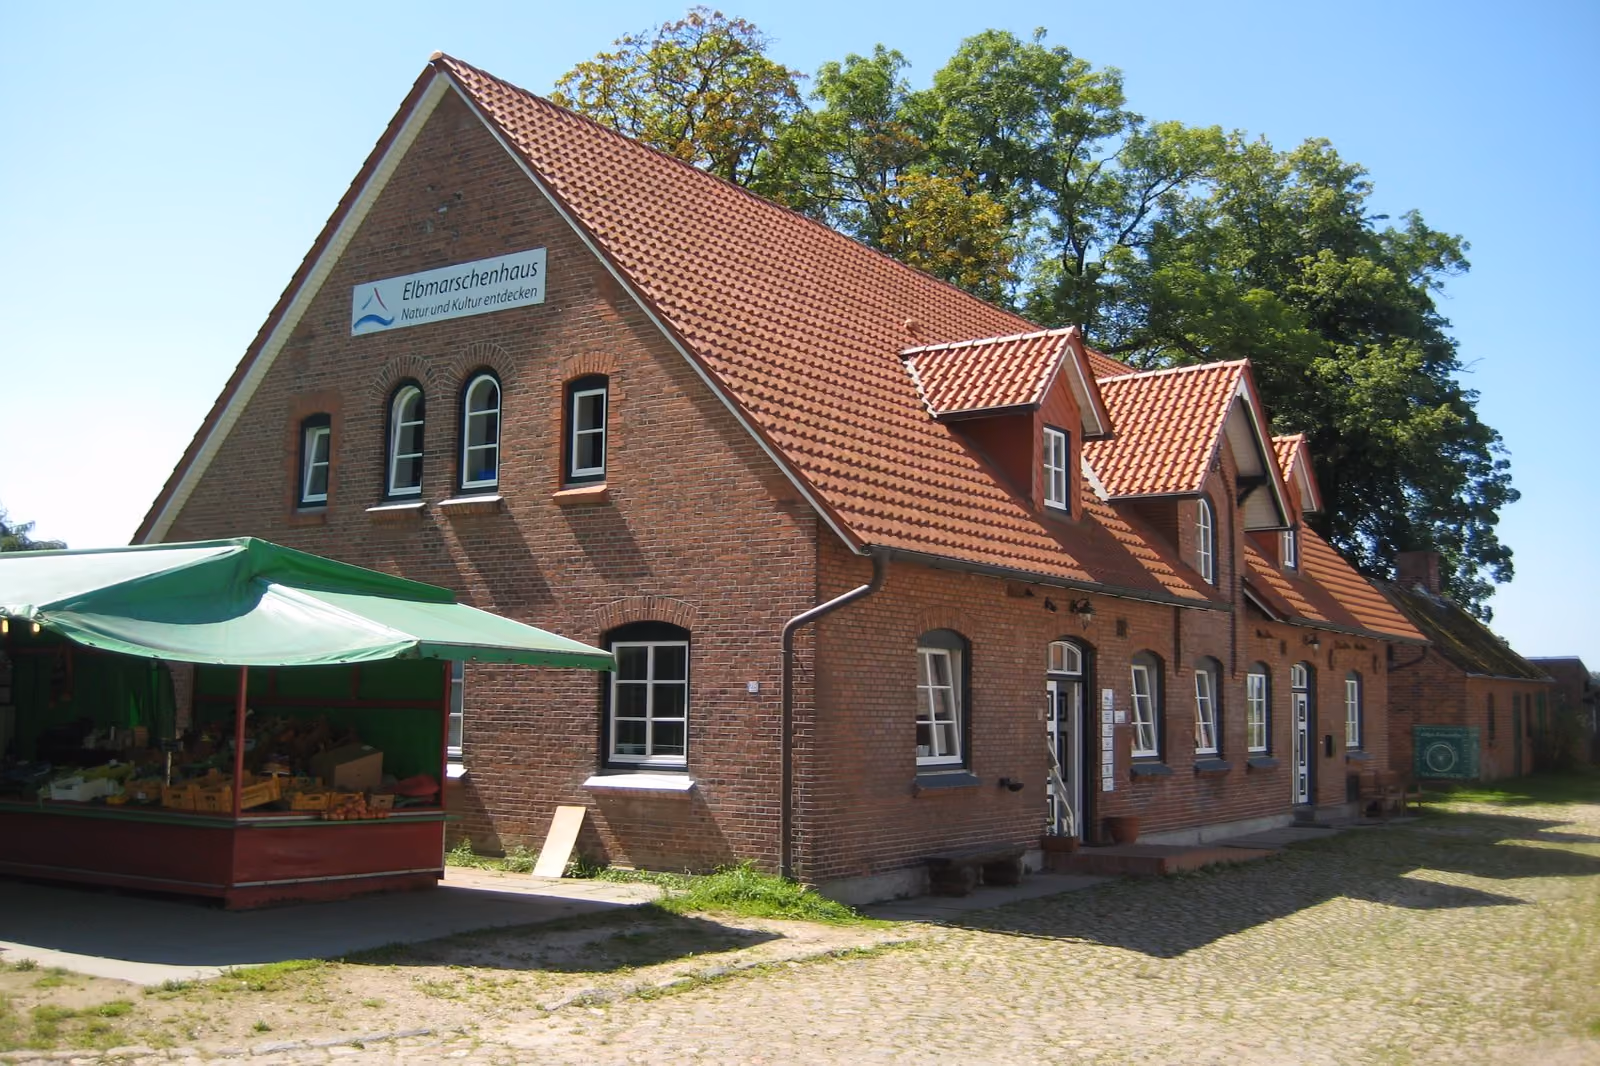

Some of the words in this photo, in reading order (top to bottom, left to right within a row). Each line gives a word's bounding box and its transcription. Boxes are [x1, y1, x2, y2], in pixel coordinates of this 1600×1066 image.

[402, 262, 538, 300] Elbmarschenhaus
[401, 307, 430, 320] Natur
[430, 300, 451, 315] und
[452, 296, 482, 311] Kultur
[483, 286, 537, 305] entdecken
